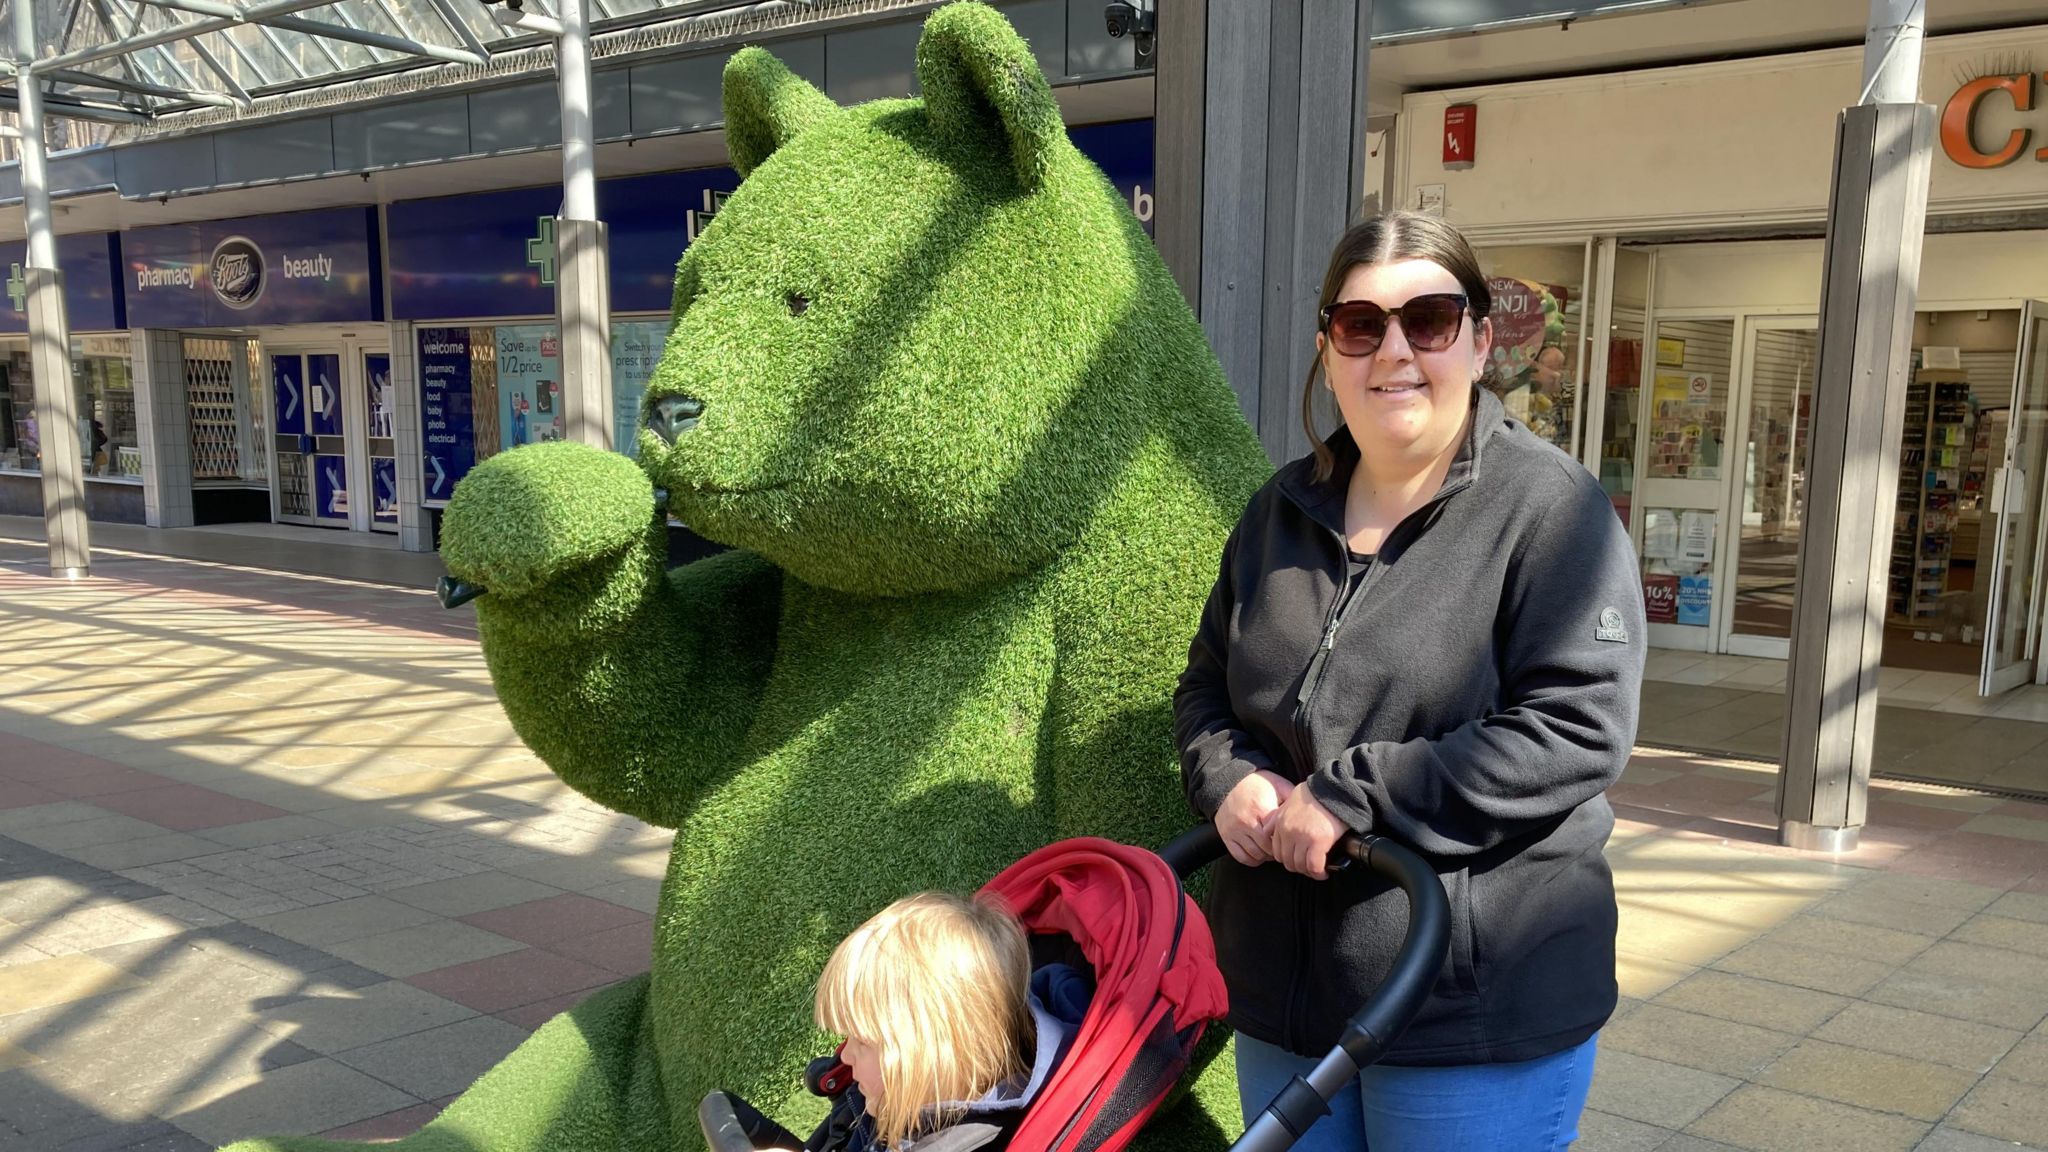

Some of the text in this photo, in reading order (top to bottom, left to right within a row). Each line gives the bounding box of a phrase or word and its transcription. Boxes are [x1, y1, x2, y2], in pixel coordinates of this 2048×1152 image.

[1940, 71, 2048, 169] C
[213, 252, 249, 290] Boots
[283, 252, 332, 281] beauty
[137, 265, 194, 291] pharmacy
[1488, 281, 1514, 291] NEW
[1490, 294, 1528, 313] ENJI
[424, 341, 464, 354] welcome
[501, 337, 524, 353] Save
[624, 342, 646, 352] Switch
[425, 364, 455, 374] pharmacy
[501, 355, 543, 377] 1/2 price
[425, 378, 447, 388] beauty
[426, 392, 441, 401] food
[427, 406, 442, 416] baby
[428, 420, 446, 430] photo
[428, 433, 456, 443] electrical
[1646, 585, 1674, 600] 10%
